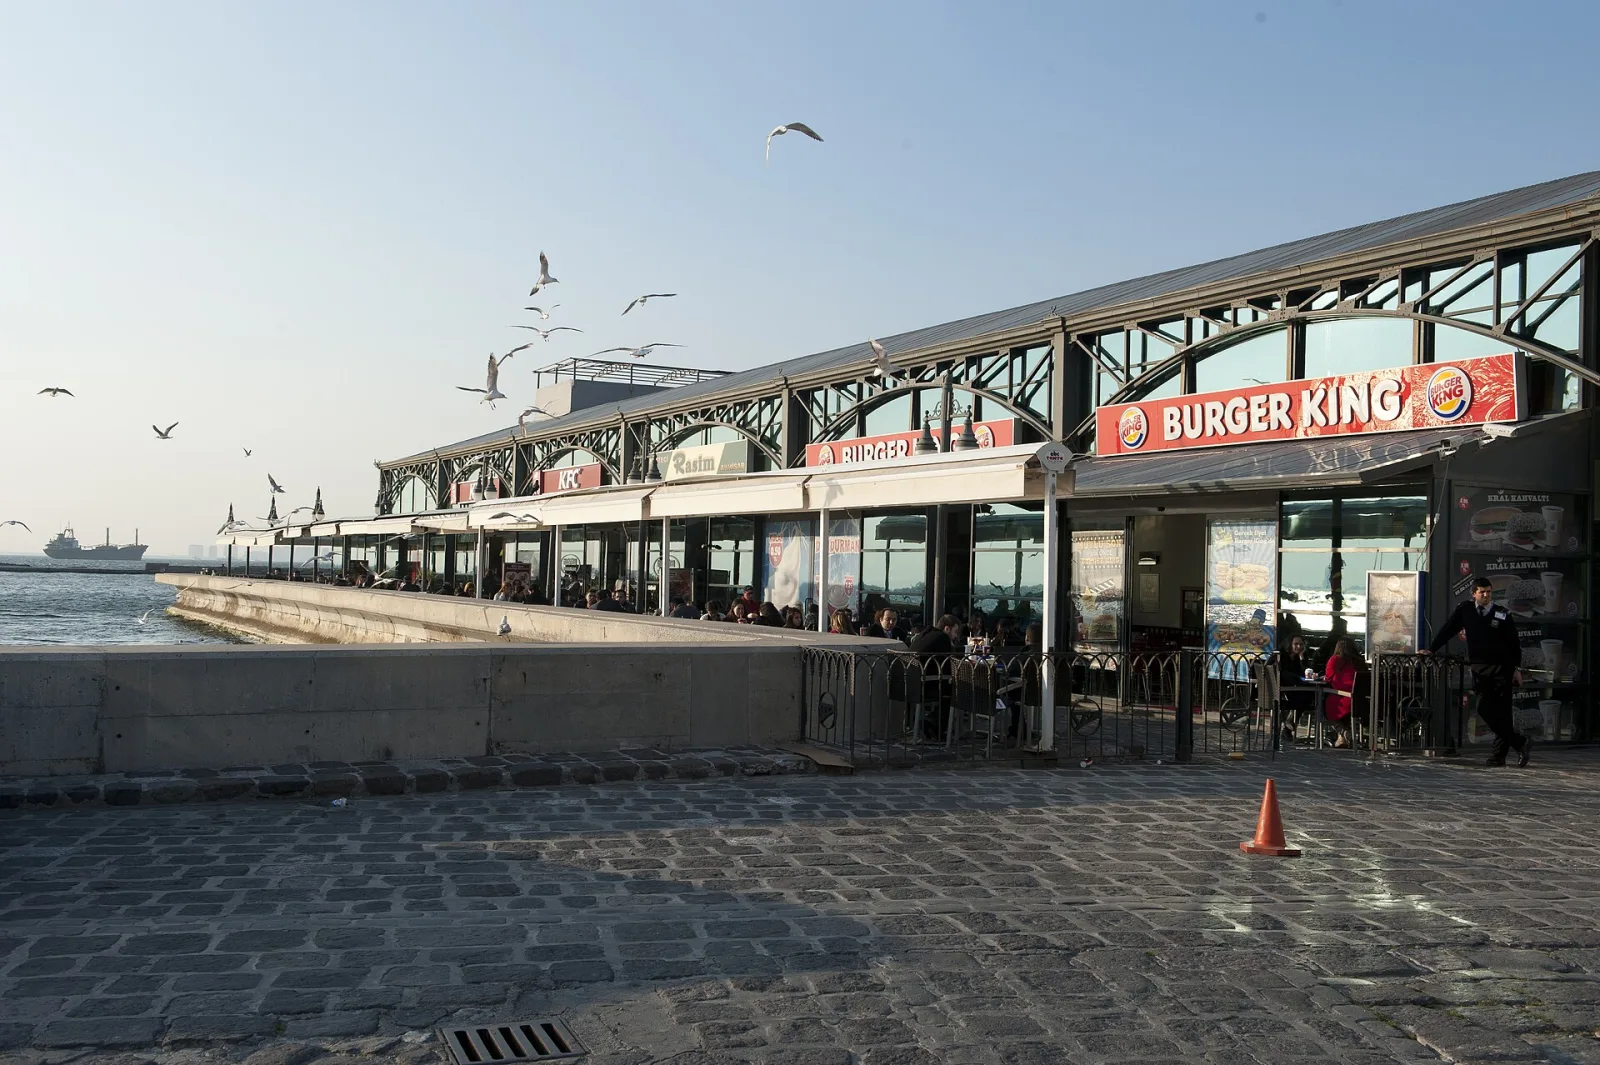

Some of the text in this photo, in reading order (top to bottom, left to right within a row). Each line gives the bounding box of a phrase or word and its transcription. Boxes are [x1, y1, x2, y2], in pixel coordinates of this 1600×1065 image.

[1431, 376, 1462, 397] BURGER
[1432, 385, 1464, 408] KING
[1163, 378, 1402, 441] BURGER KING
[1122, 421, 1142, 437] KING
[842, 440, 908, 464] BURGER
[558, 468, 580, 490] KFC
[1486, 561, 1549, 570] KRAL KAHVALTI
[1512, 691, 1540, 699] AHVALTI
